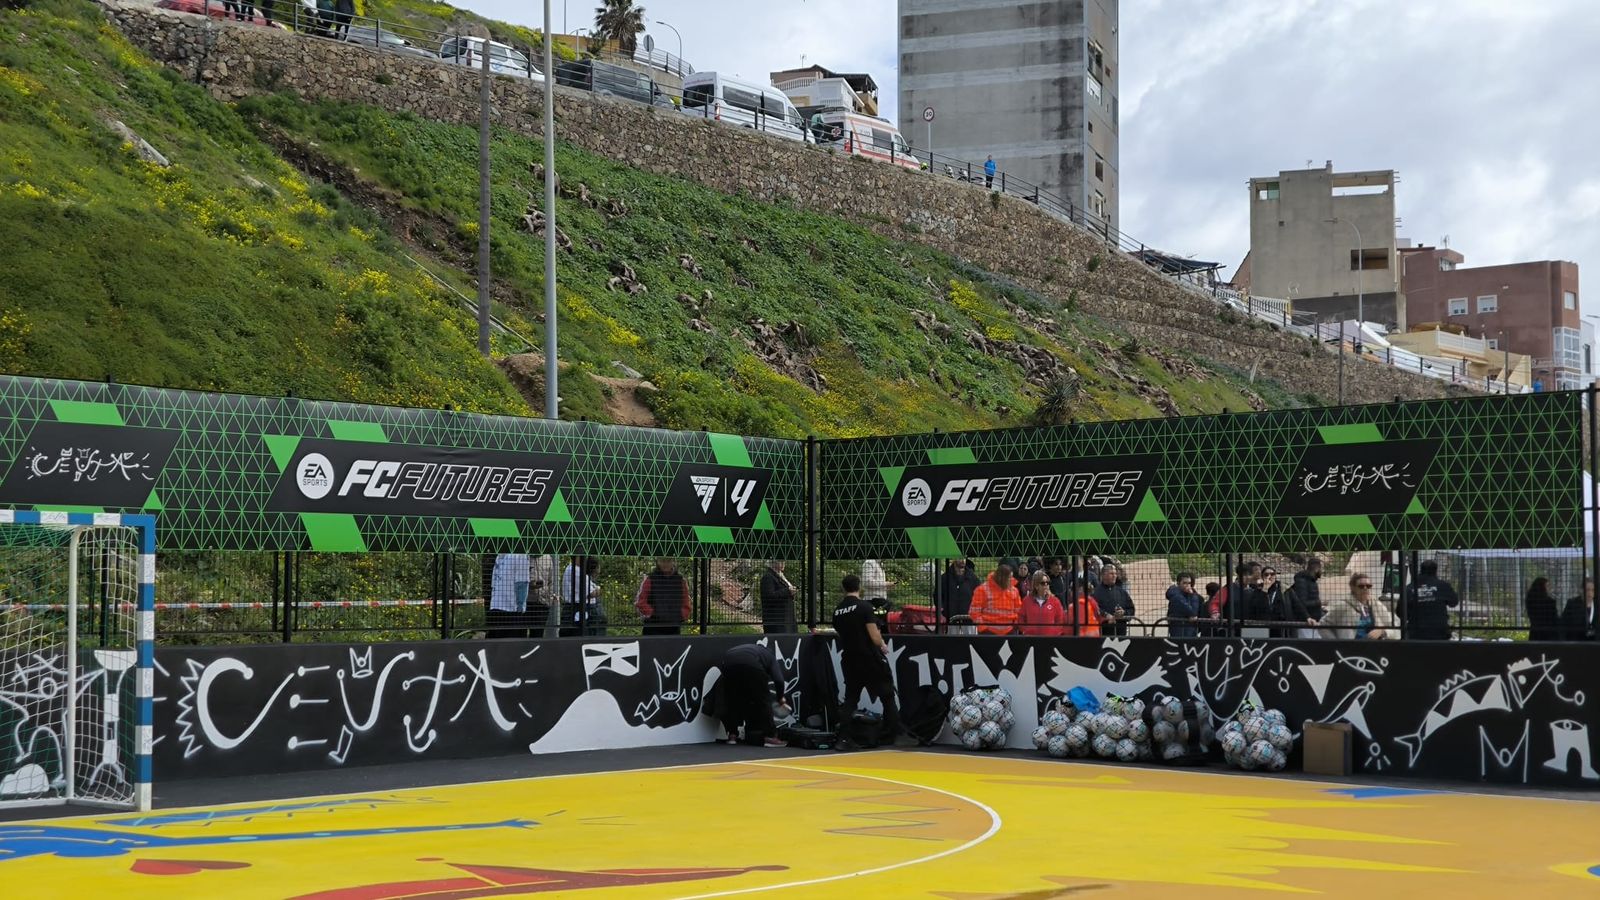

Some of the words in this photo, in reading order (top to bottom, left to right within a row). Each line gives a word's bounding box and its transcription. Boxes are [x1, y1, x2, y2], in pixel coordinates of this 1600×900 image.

[304, 463, 327, 479] EA
[302, 478, 328, 487] SPORTS
[388, 462, 553, 504] FUTURES
[907, 487, 926, 499] EA
[977, 470, 1143, 511] FUTURES
[907, 499, 927, 507] SPORTS
[834, 604, 858, 616] STAFF
